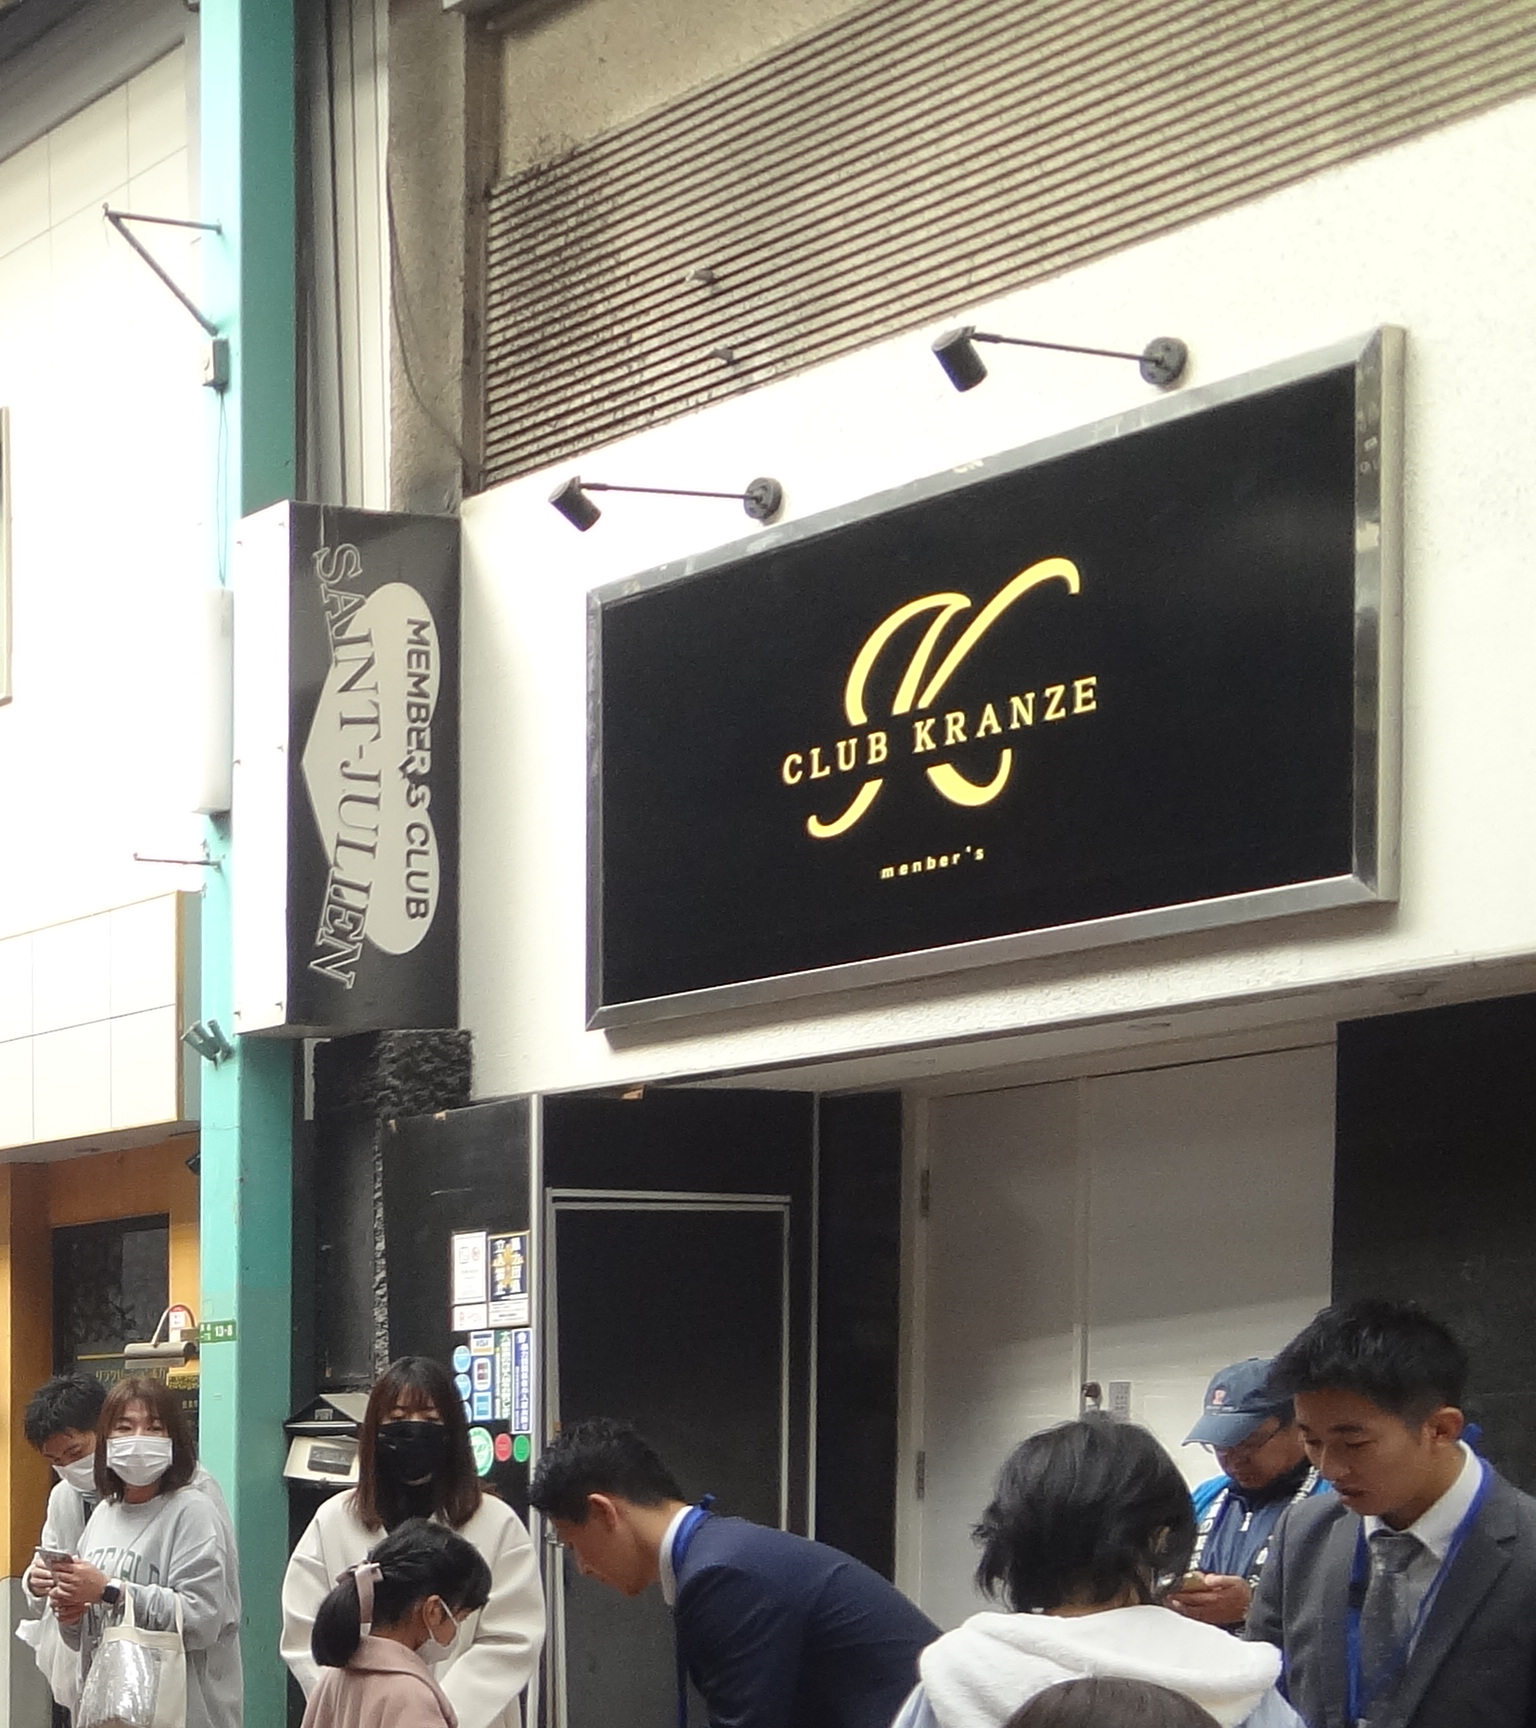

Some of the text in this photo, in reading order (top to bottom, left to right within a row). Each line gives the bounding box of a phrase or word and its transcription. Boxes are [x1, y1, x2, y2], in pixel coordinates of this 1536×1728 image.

[310, 542, 382, 989] SAINT-JULIEN
[781, 676, 1098, 786] CLUB KRANZE
[404, 820, 432, 921] CLUB
